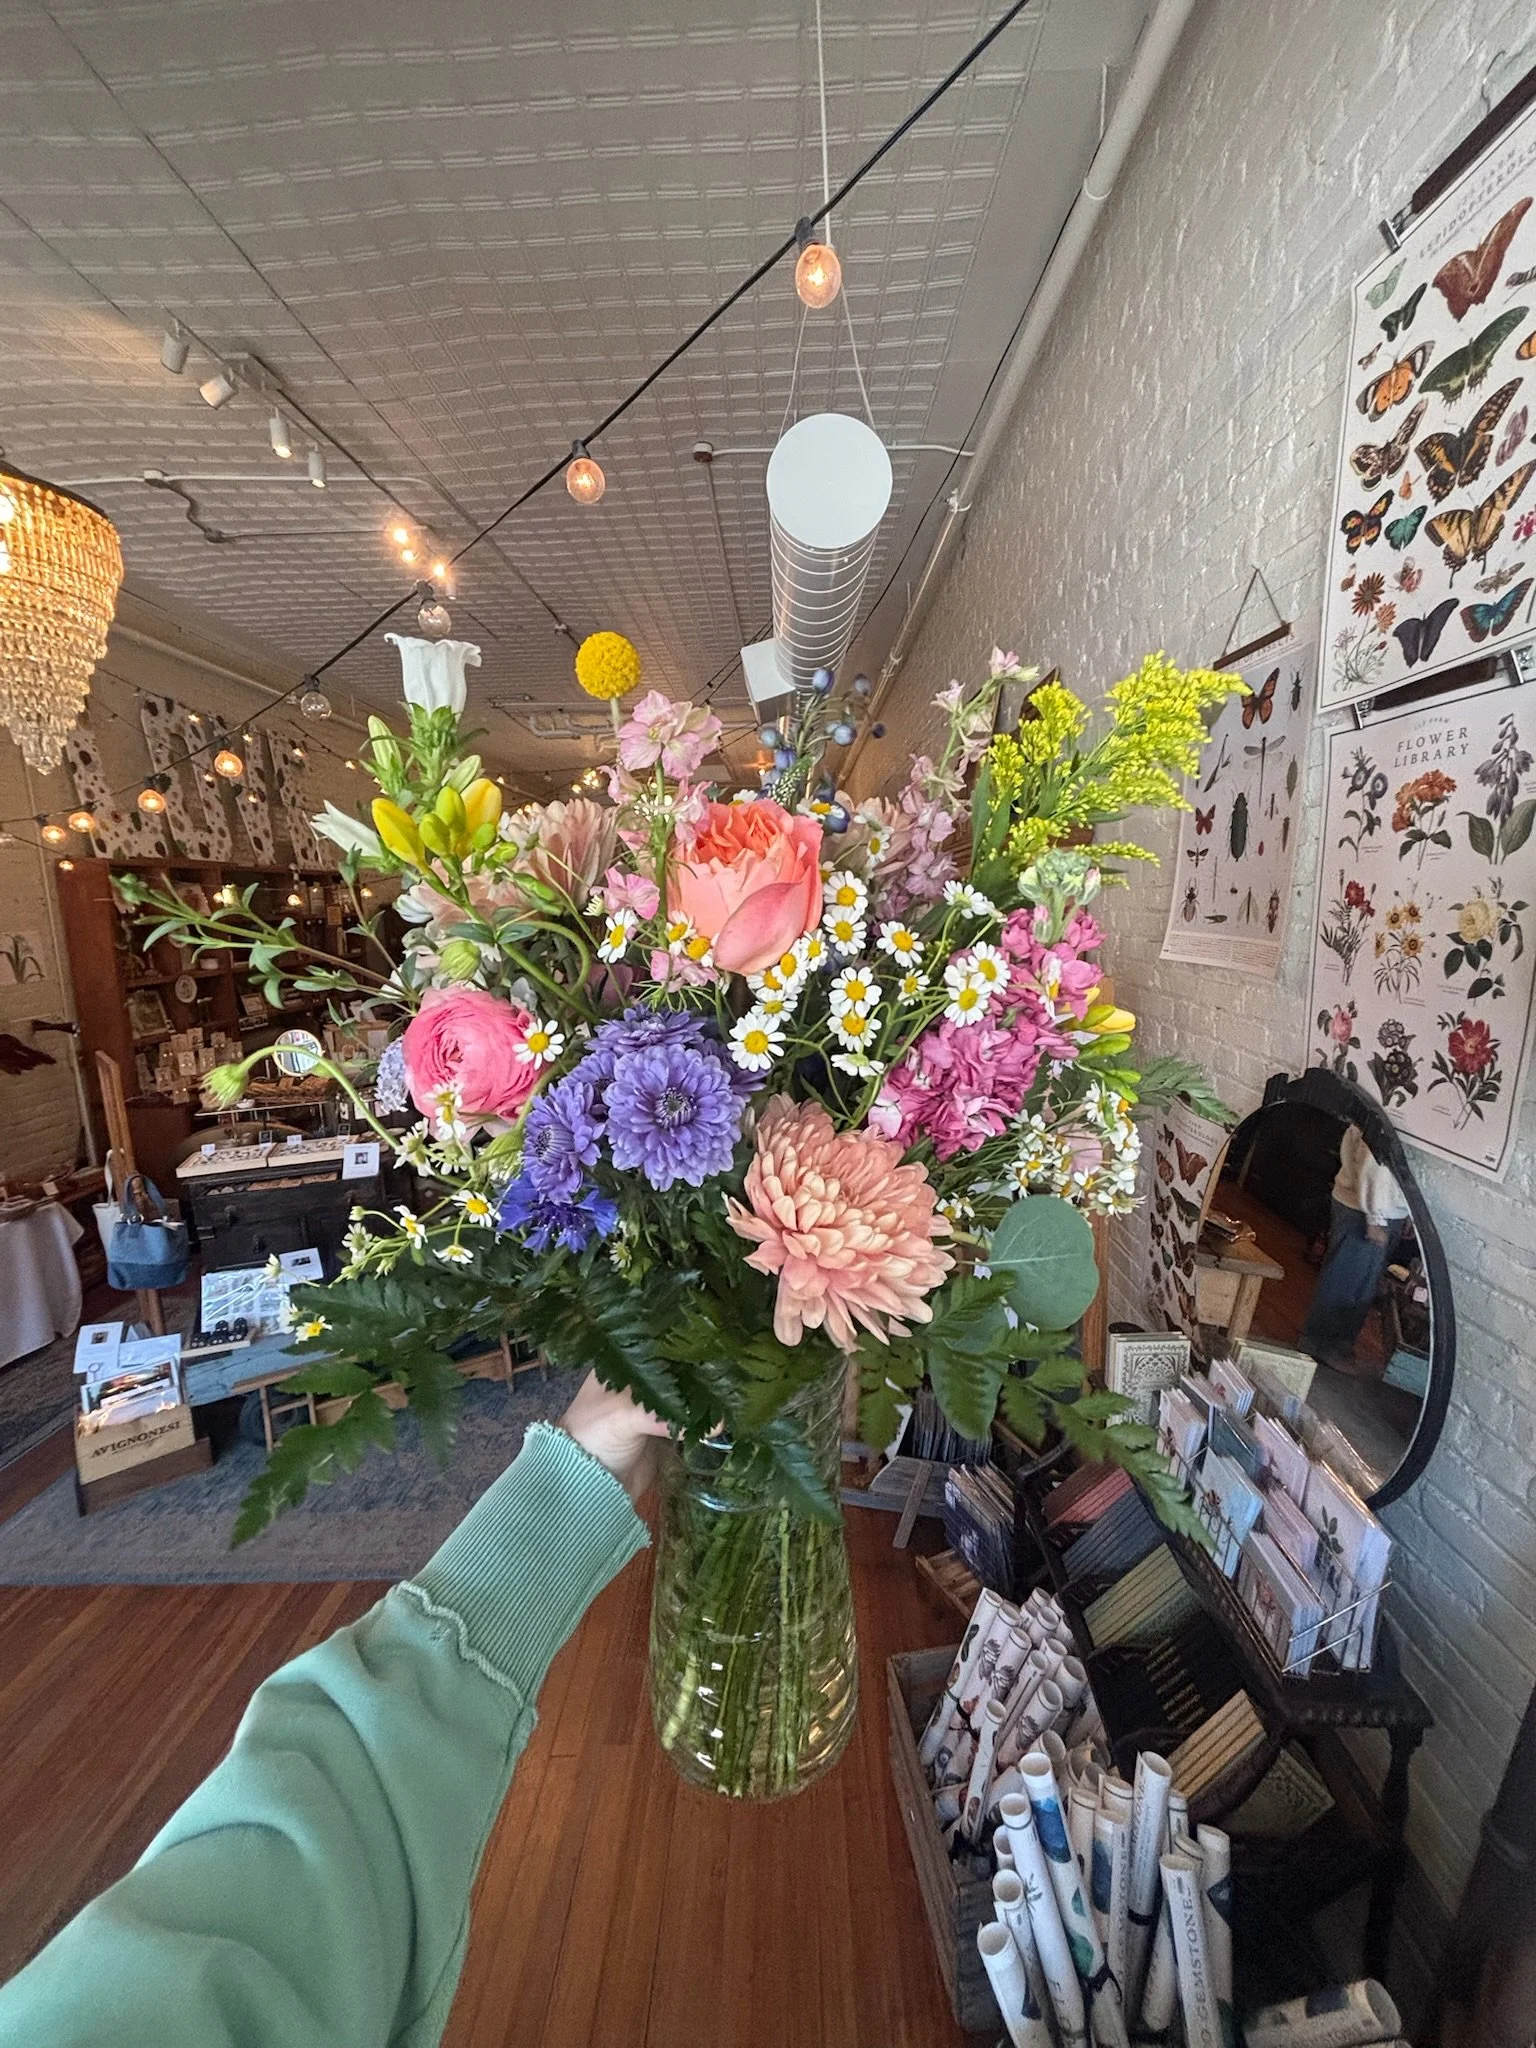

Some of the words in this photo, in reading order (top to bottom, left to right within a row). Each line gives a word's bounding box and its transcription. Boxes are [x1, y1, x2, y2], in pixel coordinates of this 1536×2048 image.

[1397, 727, 1468, 753] FLOWER
[1394, 743, 1469, 768] LIBRARY
[91, 1420, 181, 1458] AVIGNONESI
